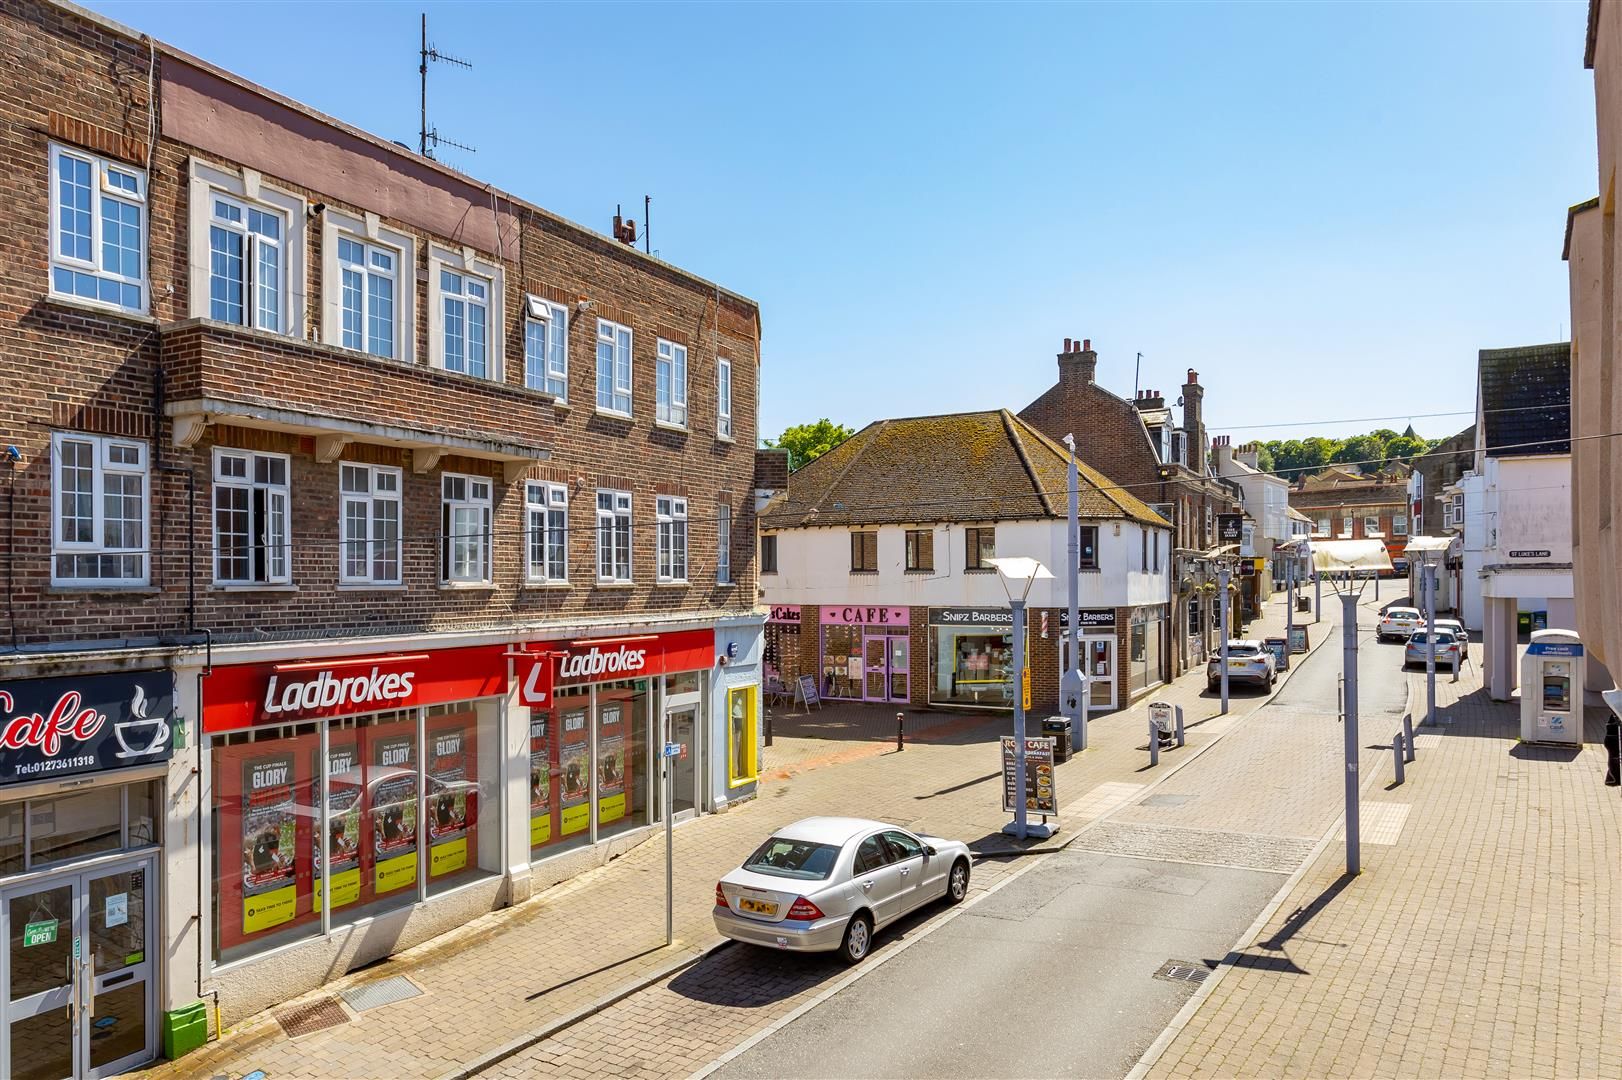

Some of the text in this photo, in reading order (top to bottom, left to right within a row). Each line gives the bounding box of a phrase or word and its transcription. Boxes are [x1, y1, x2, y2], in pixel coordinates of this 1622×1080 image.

[842, 607, 889, 623] CAFE
[561, 645, 647, 678] Ladbrokes
[264, 666, 415, 713] Ladbrokes
[565, 716, 585, 731] GLORY
[603, 710, 620, 725] GLORY
[530, 723, 545, 738] ORY
[436, 738, 461, 756] GLORY
[1027, 740, 1050, 749] CAFE
[15, 755, 95, 775] Tel:01273611318
[382, 747, 410, 766] GLORY
[328, 757, 352, 775] LORY
[252, 767, 288, 789] GLORY
[31, 932, 52, 944] OPEN
